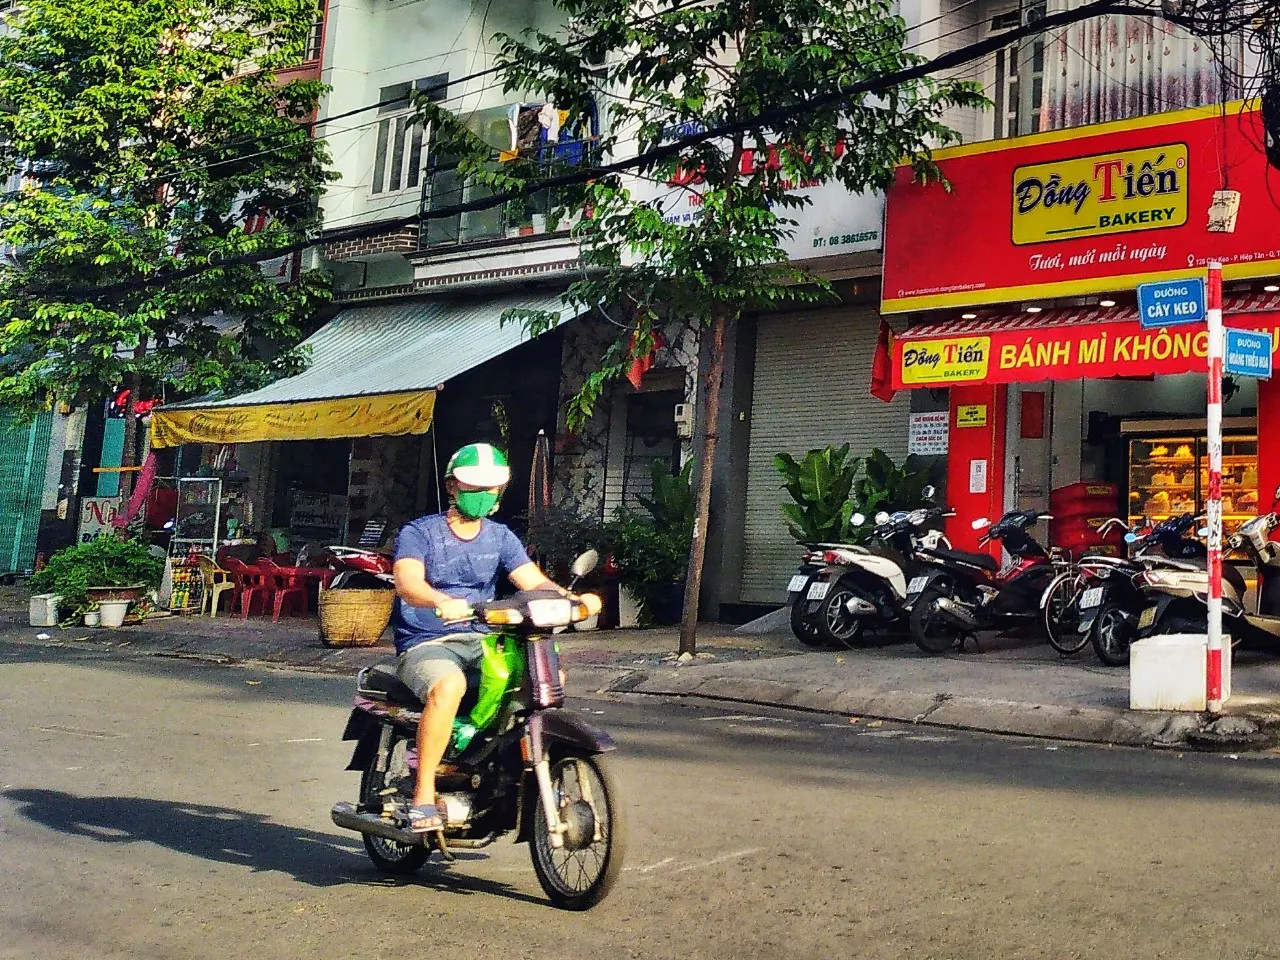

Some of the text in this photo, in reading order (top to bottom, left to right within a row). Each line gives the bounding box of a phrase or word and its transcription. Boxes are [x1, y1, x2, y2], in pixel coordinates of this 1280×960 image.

[1015, 154, 1180, 216] Đồng Tiến
[1098, 206, 1177, 229] BAKERY
[1068, 248, 1097, 267] mới
[1098, 243, 1128, 263] mỗi
[1129, 242, 1168, 262] ngày
[1153, 285, 1189, 300] ĐƯỜNG
[1147, 299, 1199, 319] CÂY KEO
[903, 336, 985, 369] Đồng Tiến
[999, 337, 1072, 371] BÁNH
[1077, 334, 1108, 364] MÌ
[1112, 328, 1210, 363] KHÔNG
[943, 367, 982, 379] BAKERY
